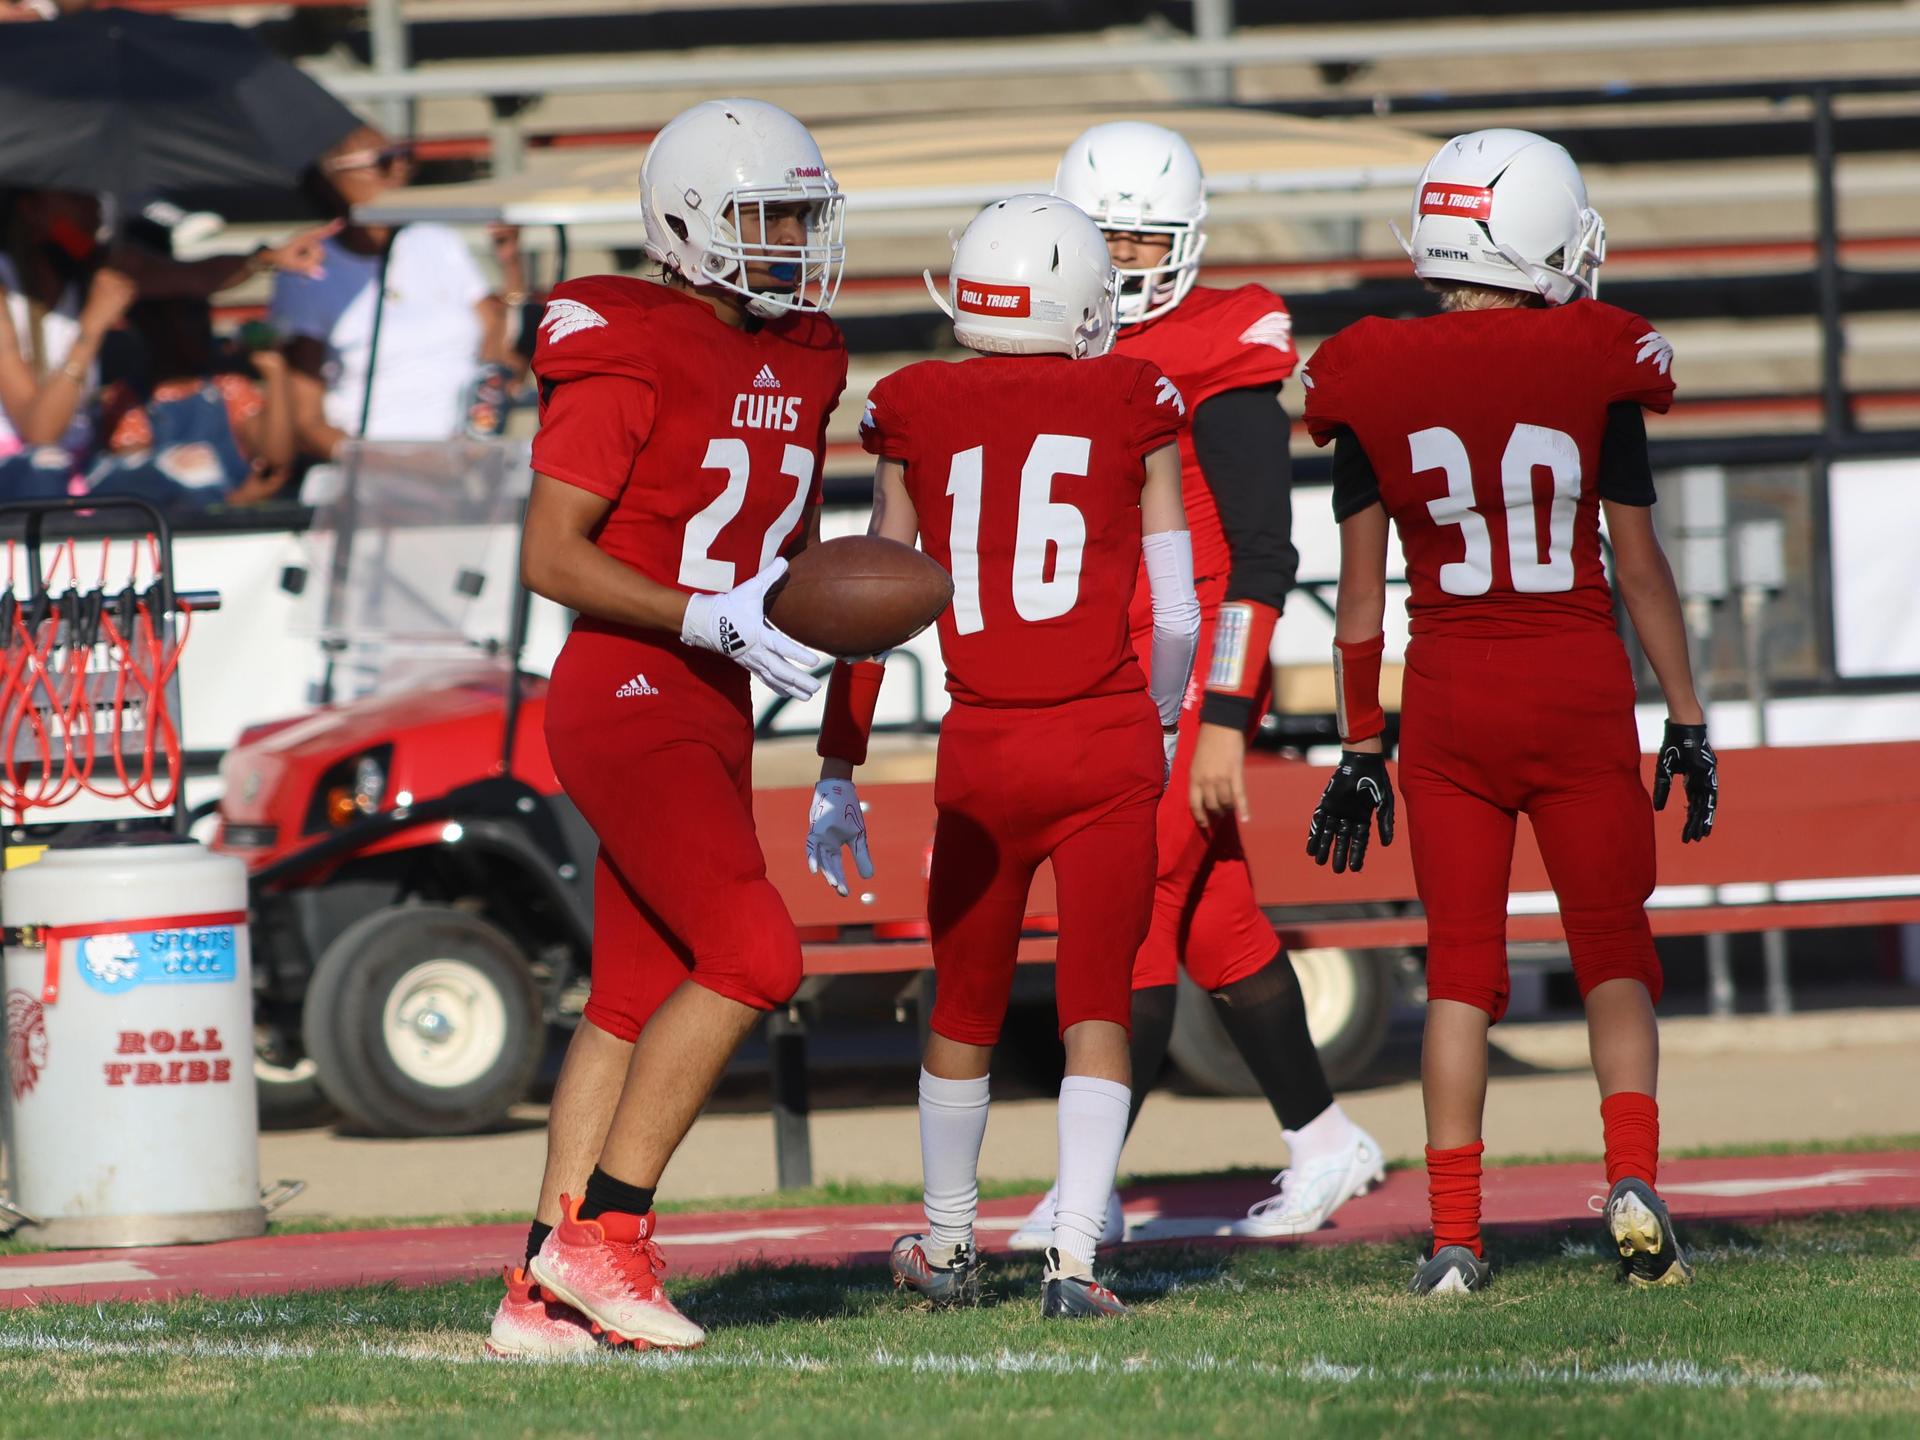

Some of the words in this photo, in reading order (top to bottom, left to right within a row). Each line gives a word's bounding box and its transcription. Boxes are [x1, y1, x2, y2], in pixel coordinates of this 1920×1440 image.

[1424, 192, 1446, 206] ROLL
[1447, 193, 1482, 209] TRIBE
[1426, 247, 1469, 260] XENITH
[961, 289, 983, 306] ROLL
[986, 293, 1020, 309] TRIBE
[753, 376, 781, 388] adidas
[731, 393, 802, 432] CUHS
[677, 438, 815, 593] 22
[1407, 422, 1582, 596] 30
[945, 433, 1092, 636] 16
[616, 684, 659, 698] adidas
[115, 1027, 223, 1054] ROLL
[103, 1058, 231, 1086] TRIBE
